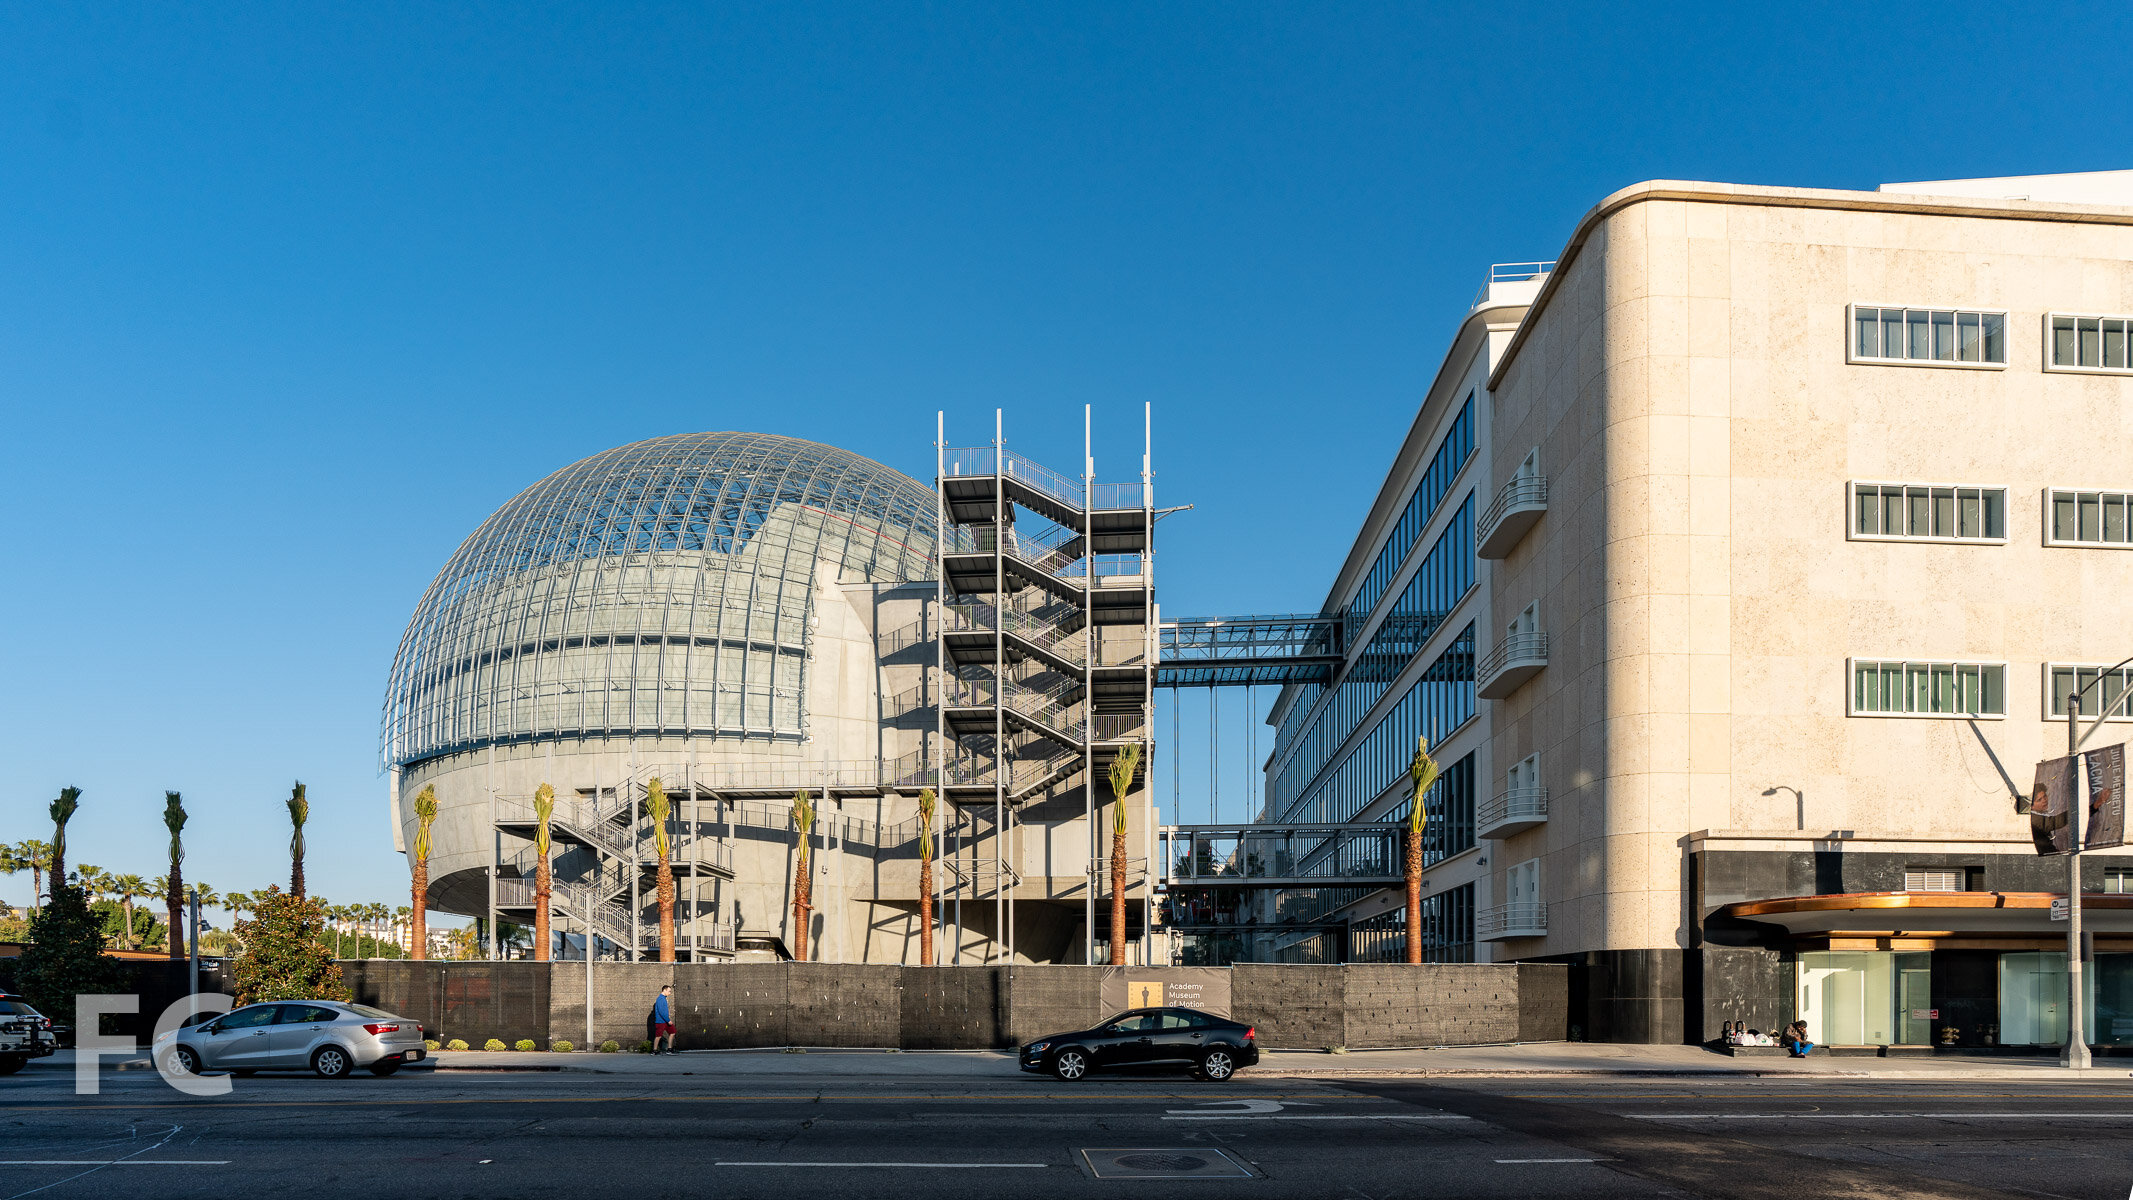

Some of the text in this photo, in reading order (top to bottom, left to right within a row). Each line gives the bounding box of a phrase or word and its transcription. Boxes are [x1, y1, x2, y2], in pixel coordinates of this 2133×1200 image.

[2088, 753, 2103, 795] LACMA
[2110, 748, 2121, 816] JULIE MEHRETU
[1169, 982, 1203, 991] Academy
[1168, 1000, 1205, 1008] of Motion
